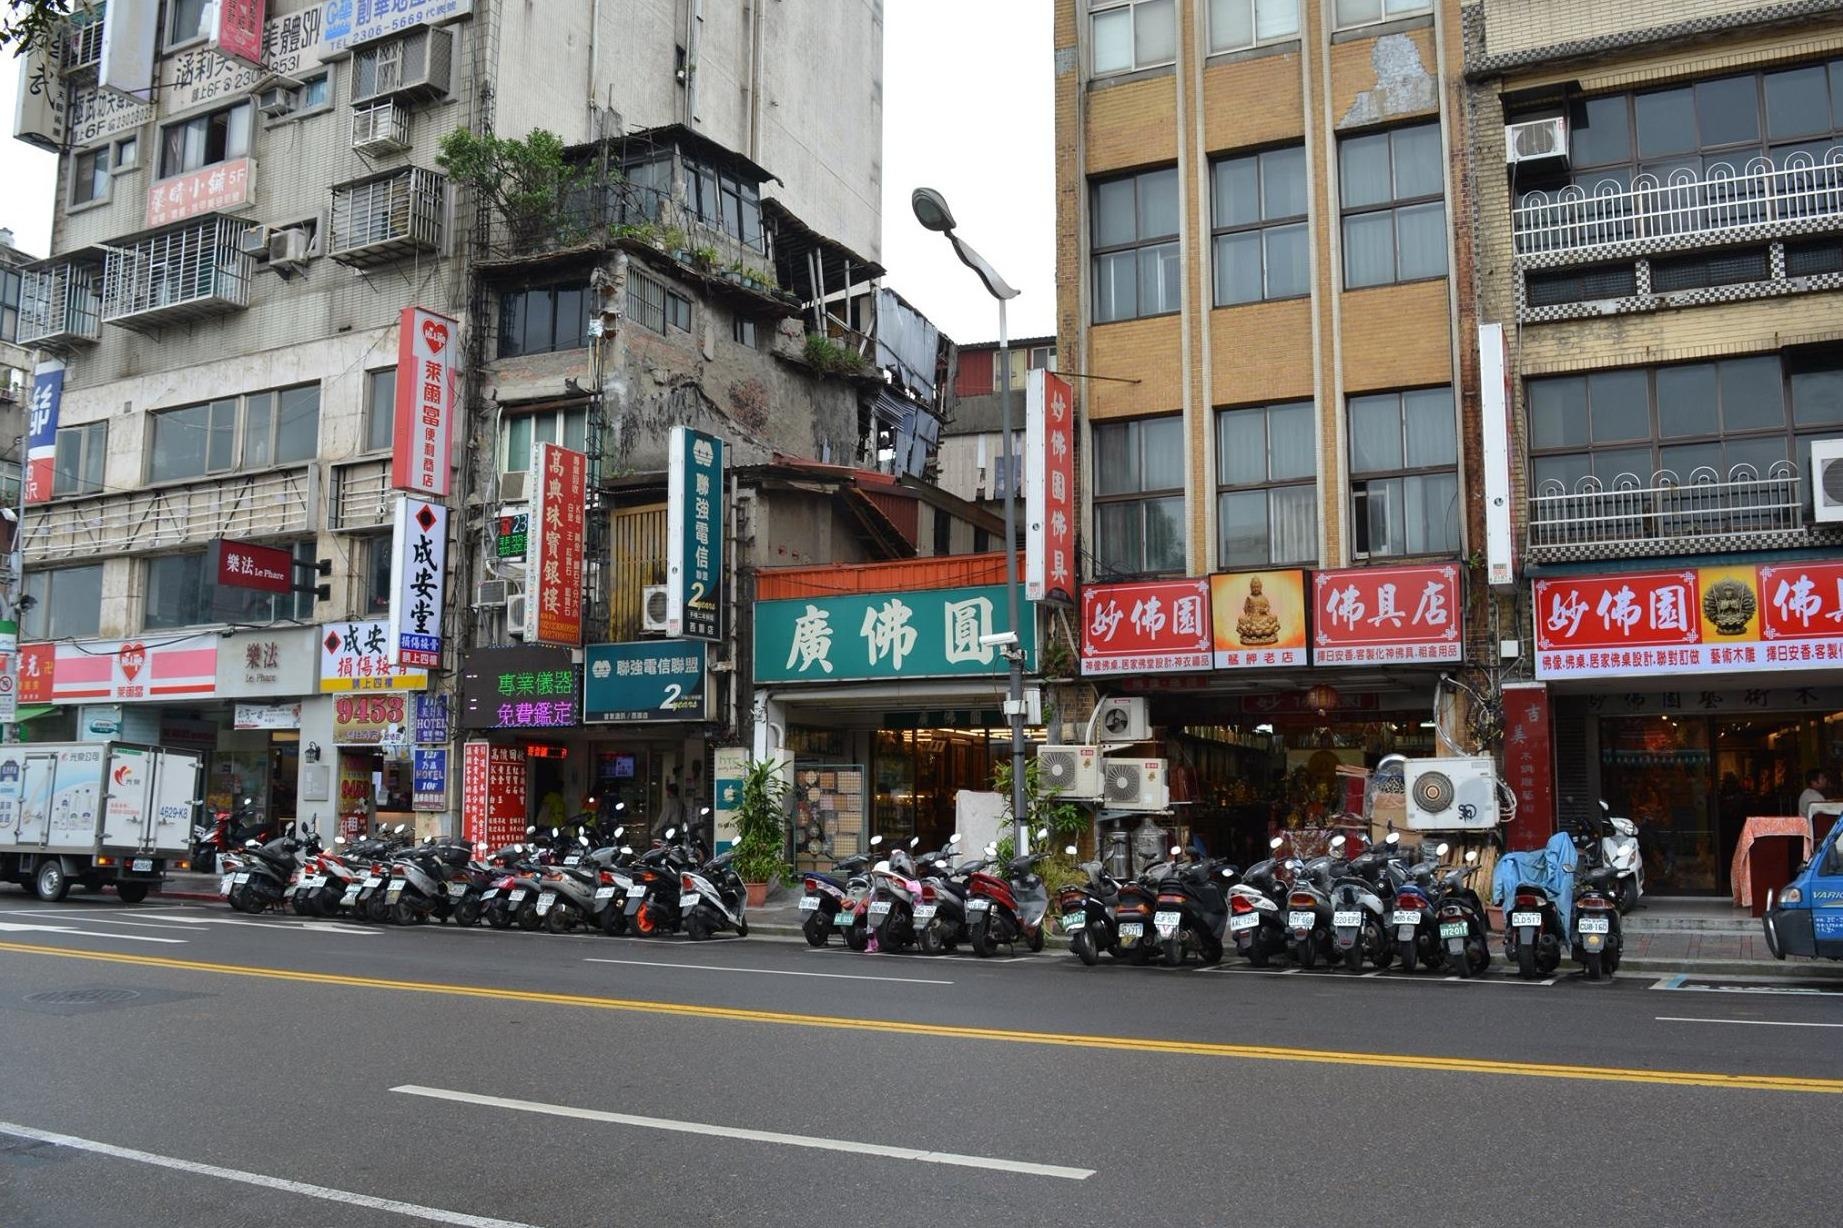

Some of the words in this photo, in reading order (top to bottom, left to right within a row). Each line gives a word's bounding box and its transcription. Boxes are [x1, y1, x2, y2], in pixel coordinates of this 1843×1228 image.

[331, 40, 348, 51] TEL
[352, 13, 423, 43] 2306-5669
[228, 168, 246, 185] 5F
[226, 552, 254, 576] 樂法
[409, 534, 439, 635] 成安堂
[688, 582, 705, 608] 2
[1090, 595, 1203, 642] 妙佛園
[1326, 581, 1448, 632] 佛具店
[1546, 585, 1688, 638] 妙佛園
[786, 596, 995, 674] 廣佛圓
[246, 642, 278, 670] 樂法
[616, 657, 699, 677] 聯強電信聯盟
[659, 683, 682, 710] 2
[417, 718, 447, 730] HOTEL
[496, 702, 573, 726] 免費鑑定
[415, 770, 444, 781] HOTEL
